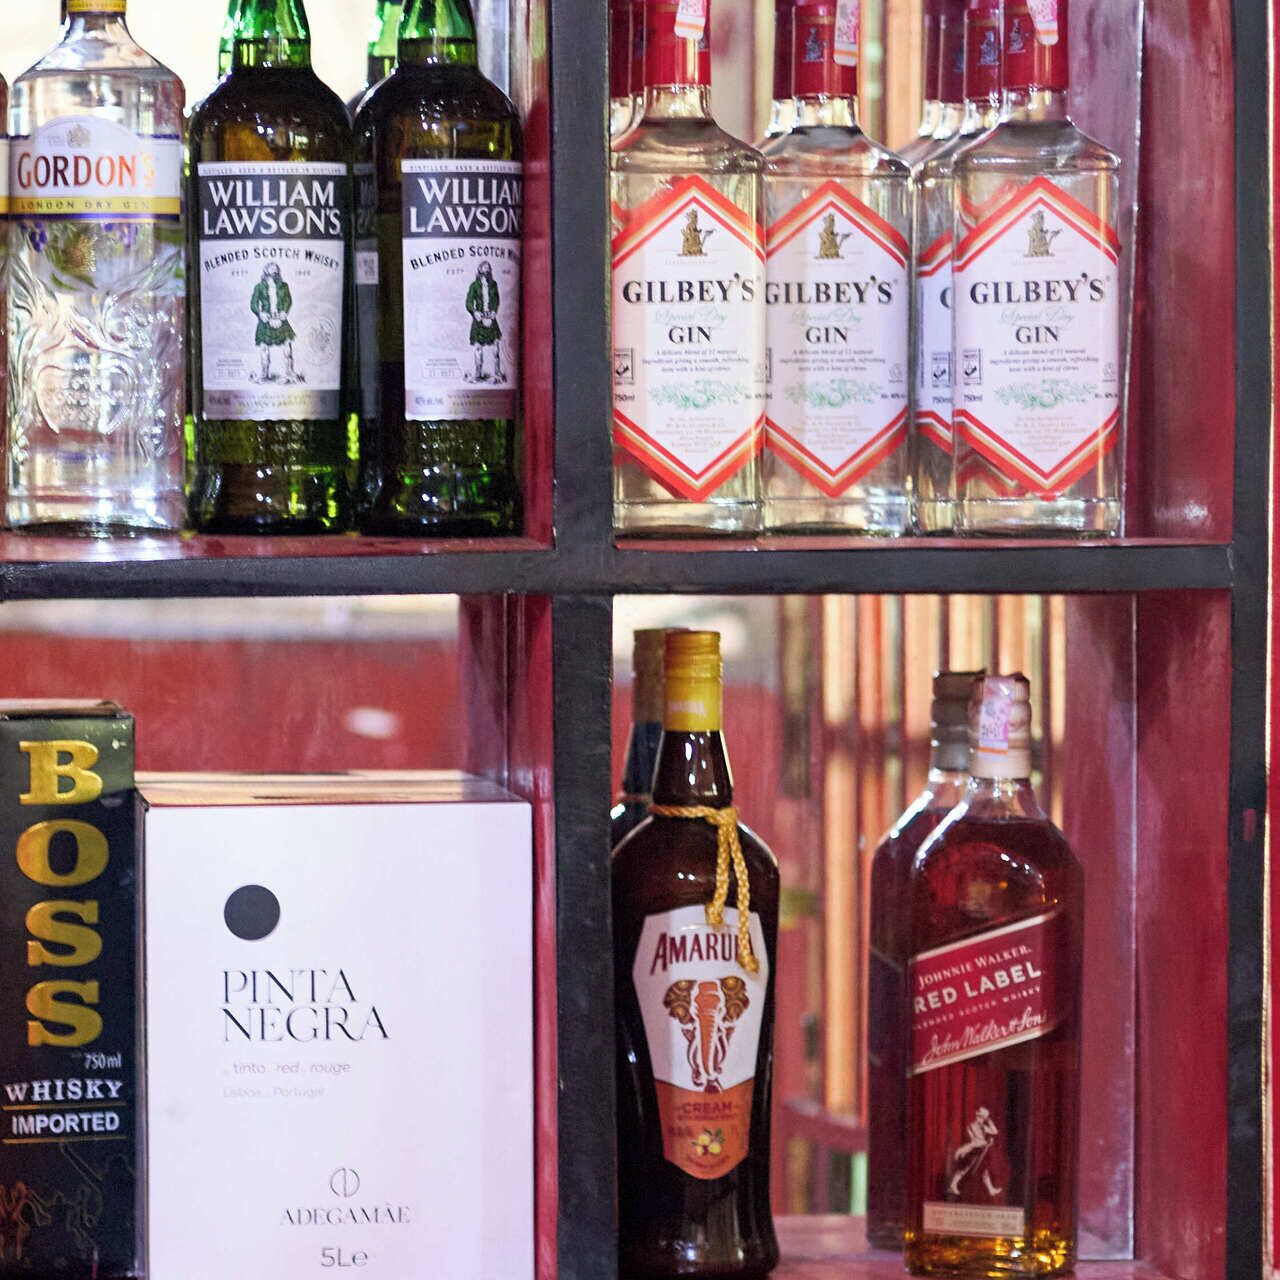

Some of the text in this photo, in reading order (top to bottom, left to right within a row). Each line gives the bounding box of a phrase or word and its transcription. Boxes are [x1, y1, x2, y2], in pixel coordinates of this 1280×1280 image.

[17, 152, 156, 189] GORDON'S
[21, 199, 75, 210] LONDON
[84, 199, 113, 210] DRY
[208, 180, 335, 207] WILLIAM
[203, 207, 342, 236] LAWSON'S
[410, 206, 520, 233] LAWSON
[204, 247, 339, 272] BLENDED SCOTCH WHISKY
[410, 247, 465, 270] BLENDED
[470, 245, 505, 259] SCOTCH
[622, 272, 755, 304] GILBEY'S
[765, 275, 892, 305] GILBEY'S
[970, 272, 1105, 305] GILBEY'S
[668, 326, 712, 344] GIN
[805, 326, 849, 344] GIN
[1015, 326, 1060, 344] GIN
[16, 740, 110, 1048] BOSS
[650, 932, 756, 976] AMARU
[221, 967, 358, 1004] PINTA
[914, 961, 1042, 1015] RED LABEL
[918, 963, 973, 990] JOHNNIE
[220, 1004, 390, 1043] NEGRA
[233, 1061, 352, 1078] tinto red rouge
[4, 1077, 124, 1102] WHISKY
[11, 1111, 121, 1136] IMPORTED
